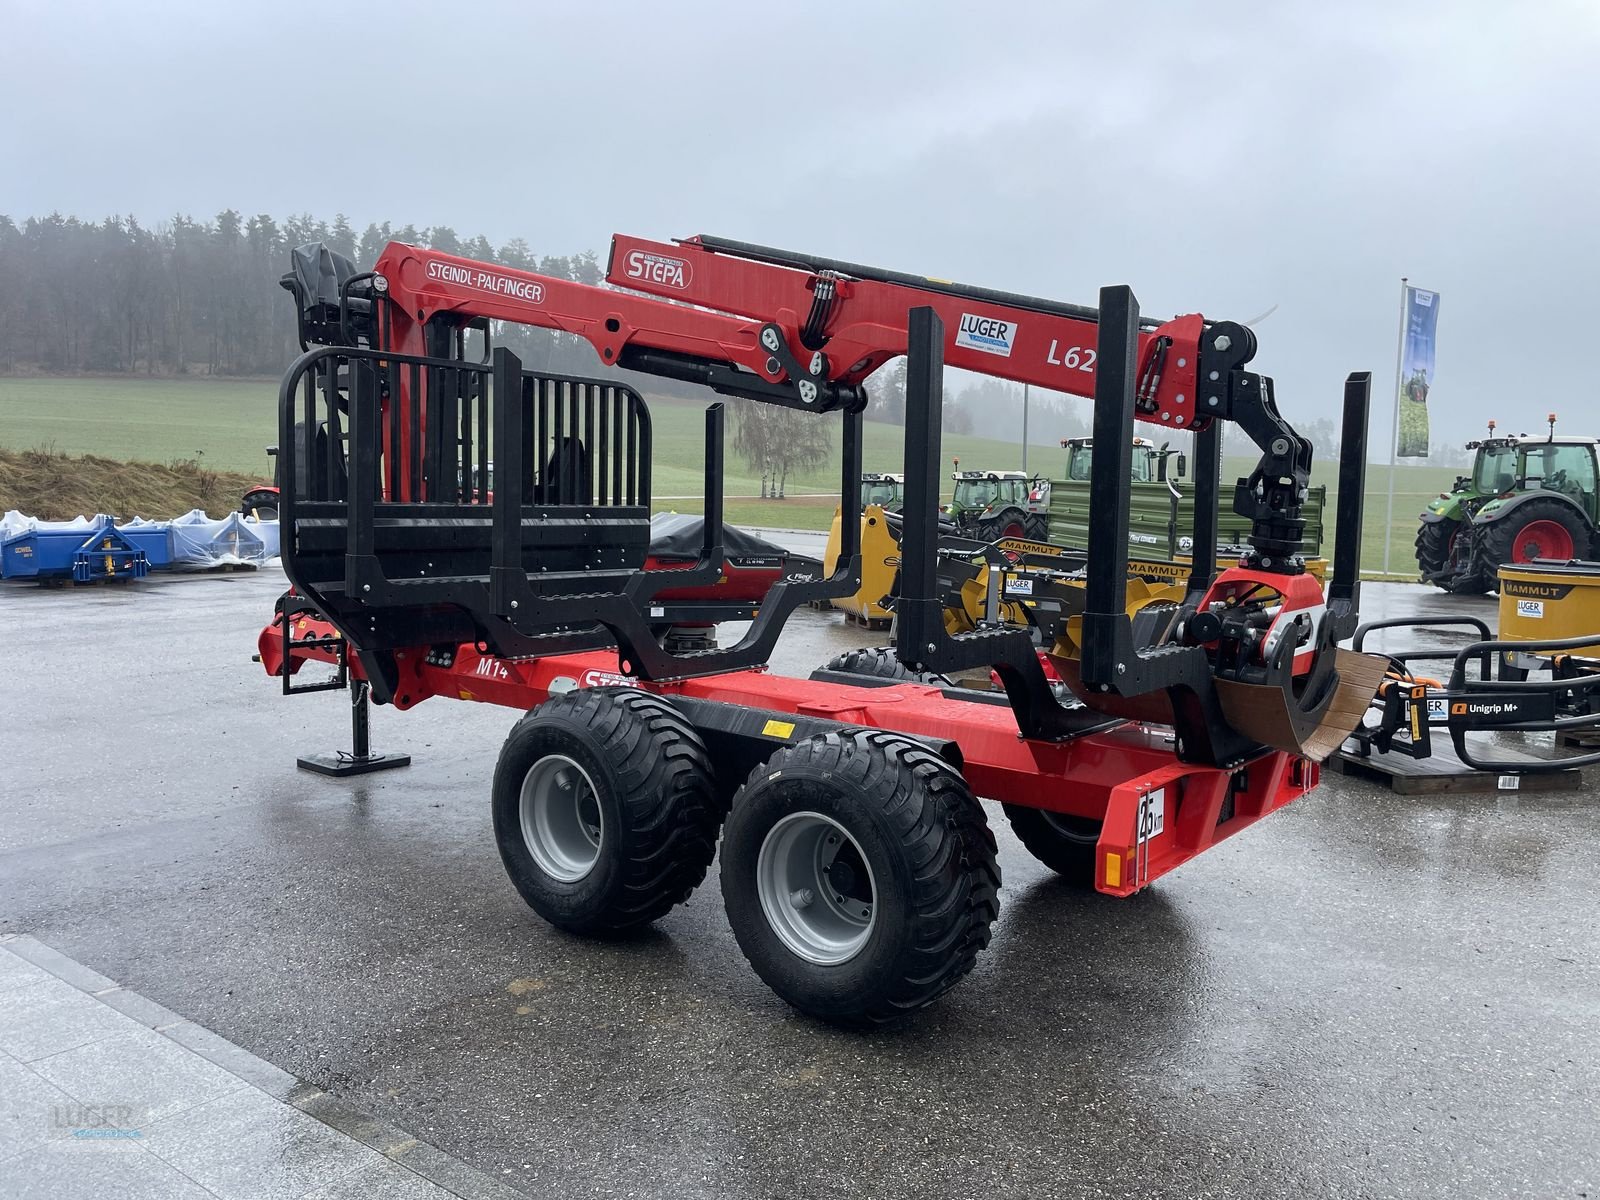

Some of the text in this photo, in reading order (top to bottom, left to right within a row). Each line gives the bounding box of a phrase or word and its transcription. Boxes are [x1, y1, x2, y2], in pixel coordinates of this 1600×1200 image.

[628, 252, 684, 287] STEPA
[428, 262, 542, 301] STEINDL-PALFINGER
[960, 315, 1008, 341] LUGER
[1005, 541, 1055, 555] MAMMUT
[1181, 539, 1191, 549] 25
[1127, 563, 1187, 577] MAMMUT
[1007, 580, 1029, 588] LUGER
[1505, 583, 1560, 597] MAMMUT
[1518, 601, 1540, 611] LUGER
[1469, 703, 1518, 714] Unigrip M+
